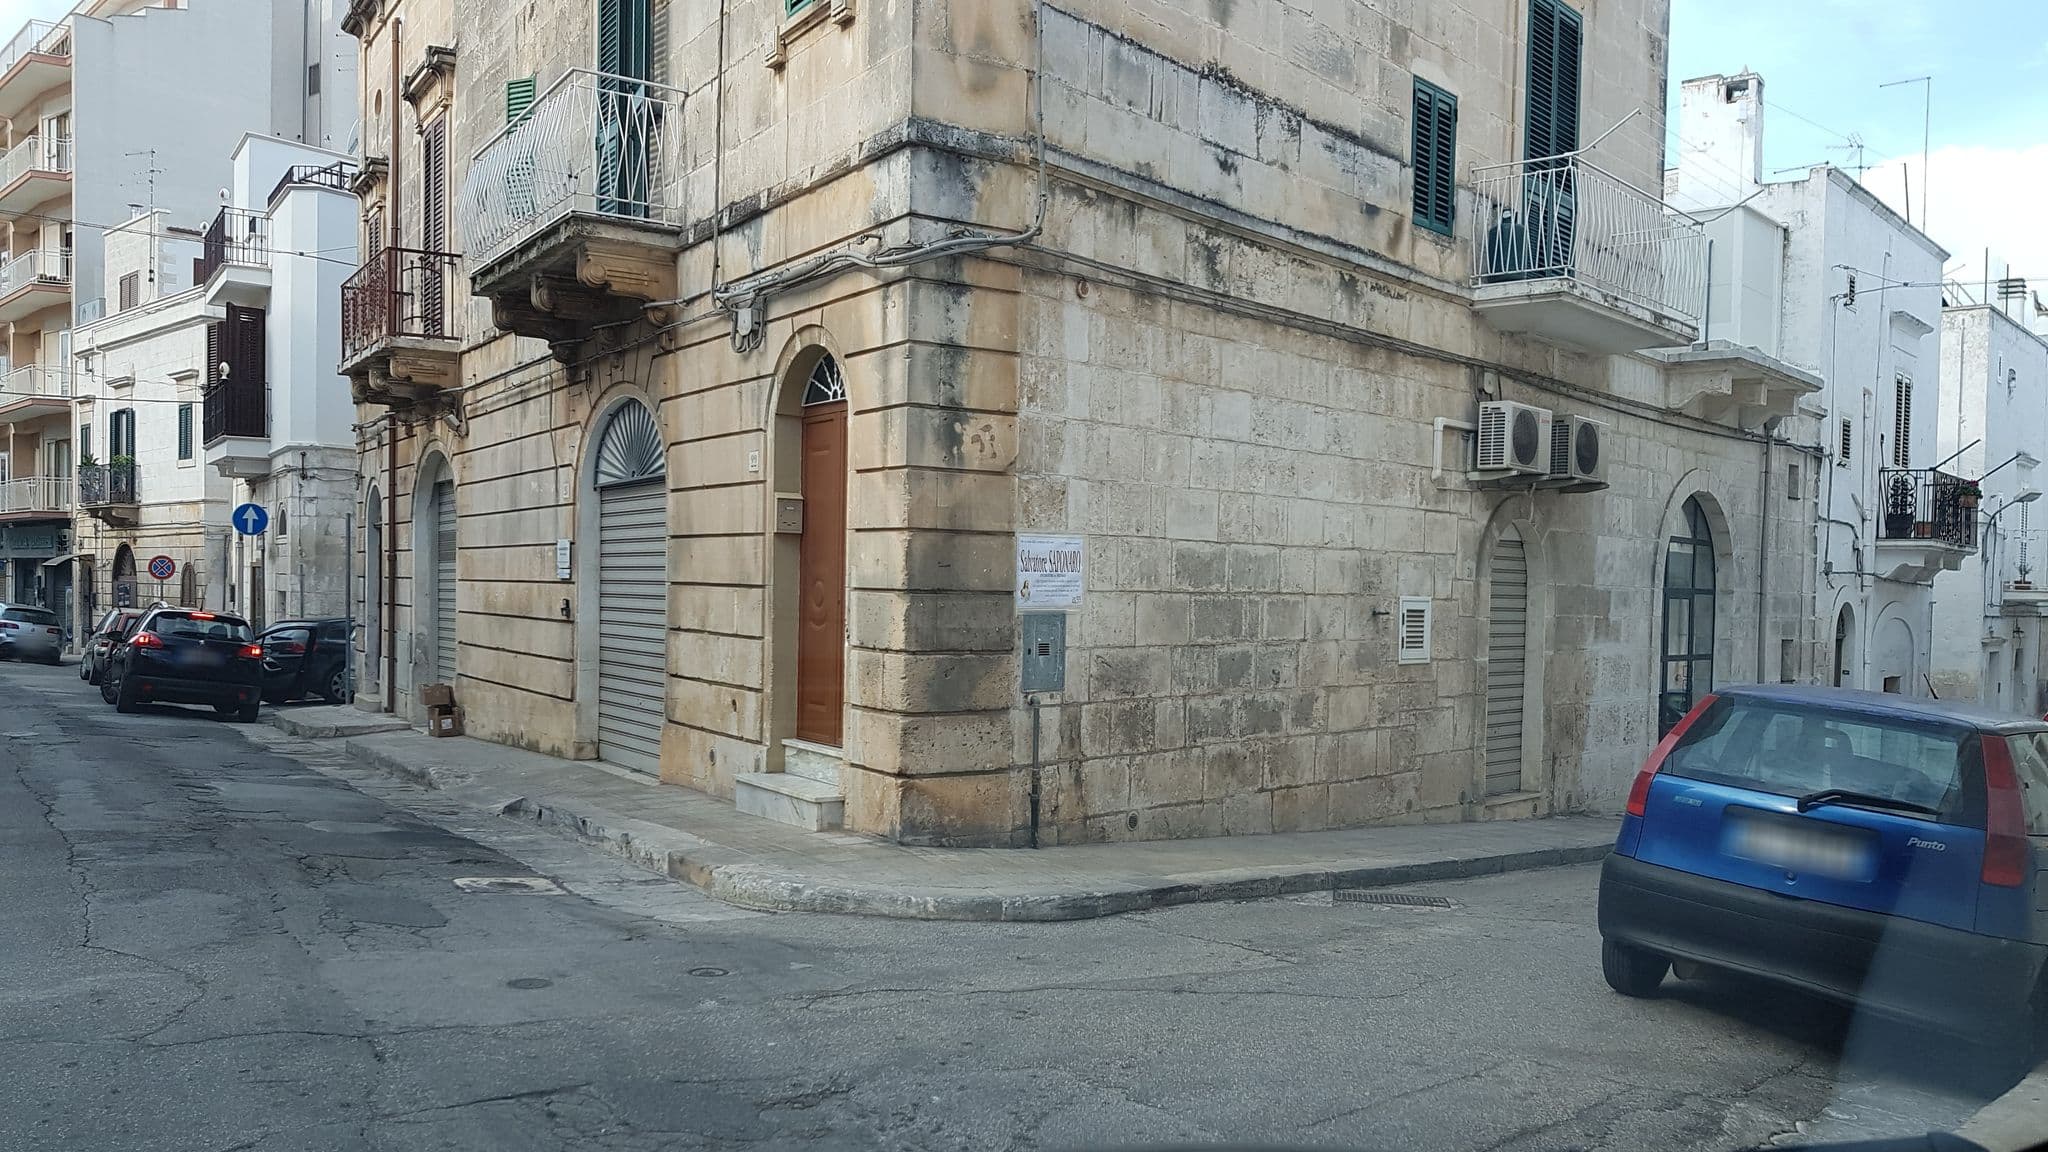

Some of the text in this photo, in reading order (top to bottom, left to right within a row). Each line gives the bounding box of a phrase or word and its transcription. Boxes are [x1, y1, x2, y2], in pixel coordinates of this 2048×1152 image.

[1020, 549, 1081, 573] Salvatore SAPONARO
[1906, 836, 1946, 851] Punto
